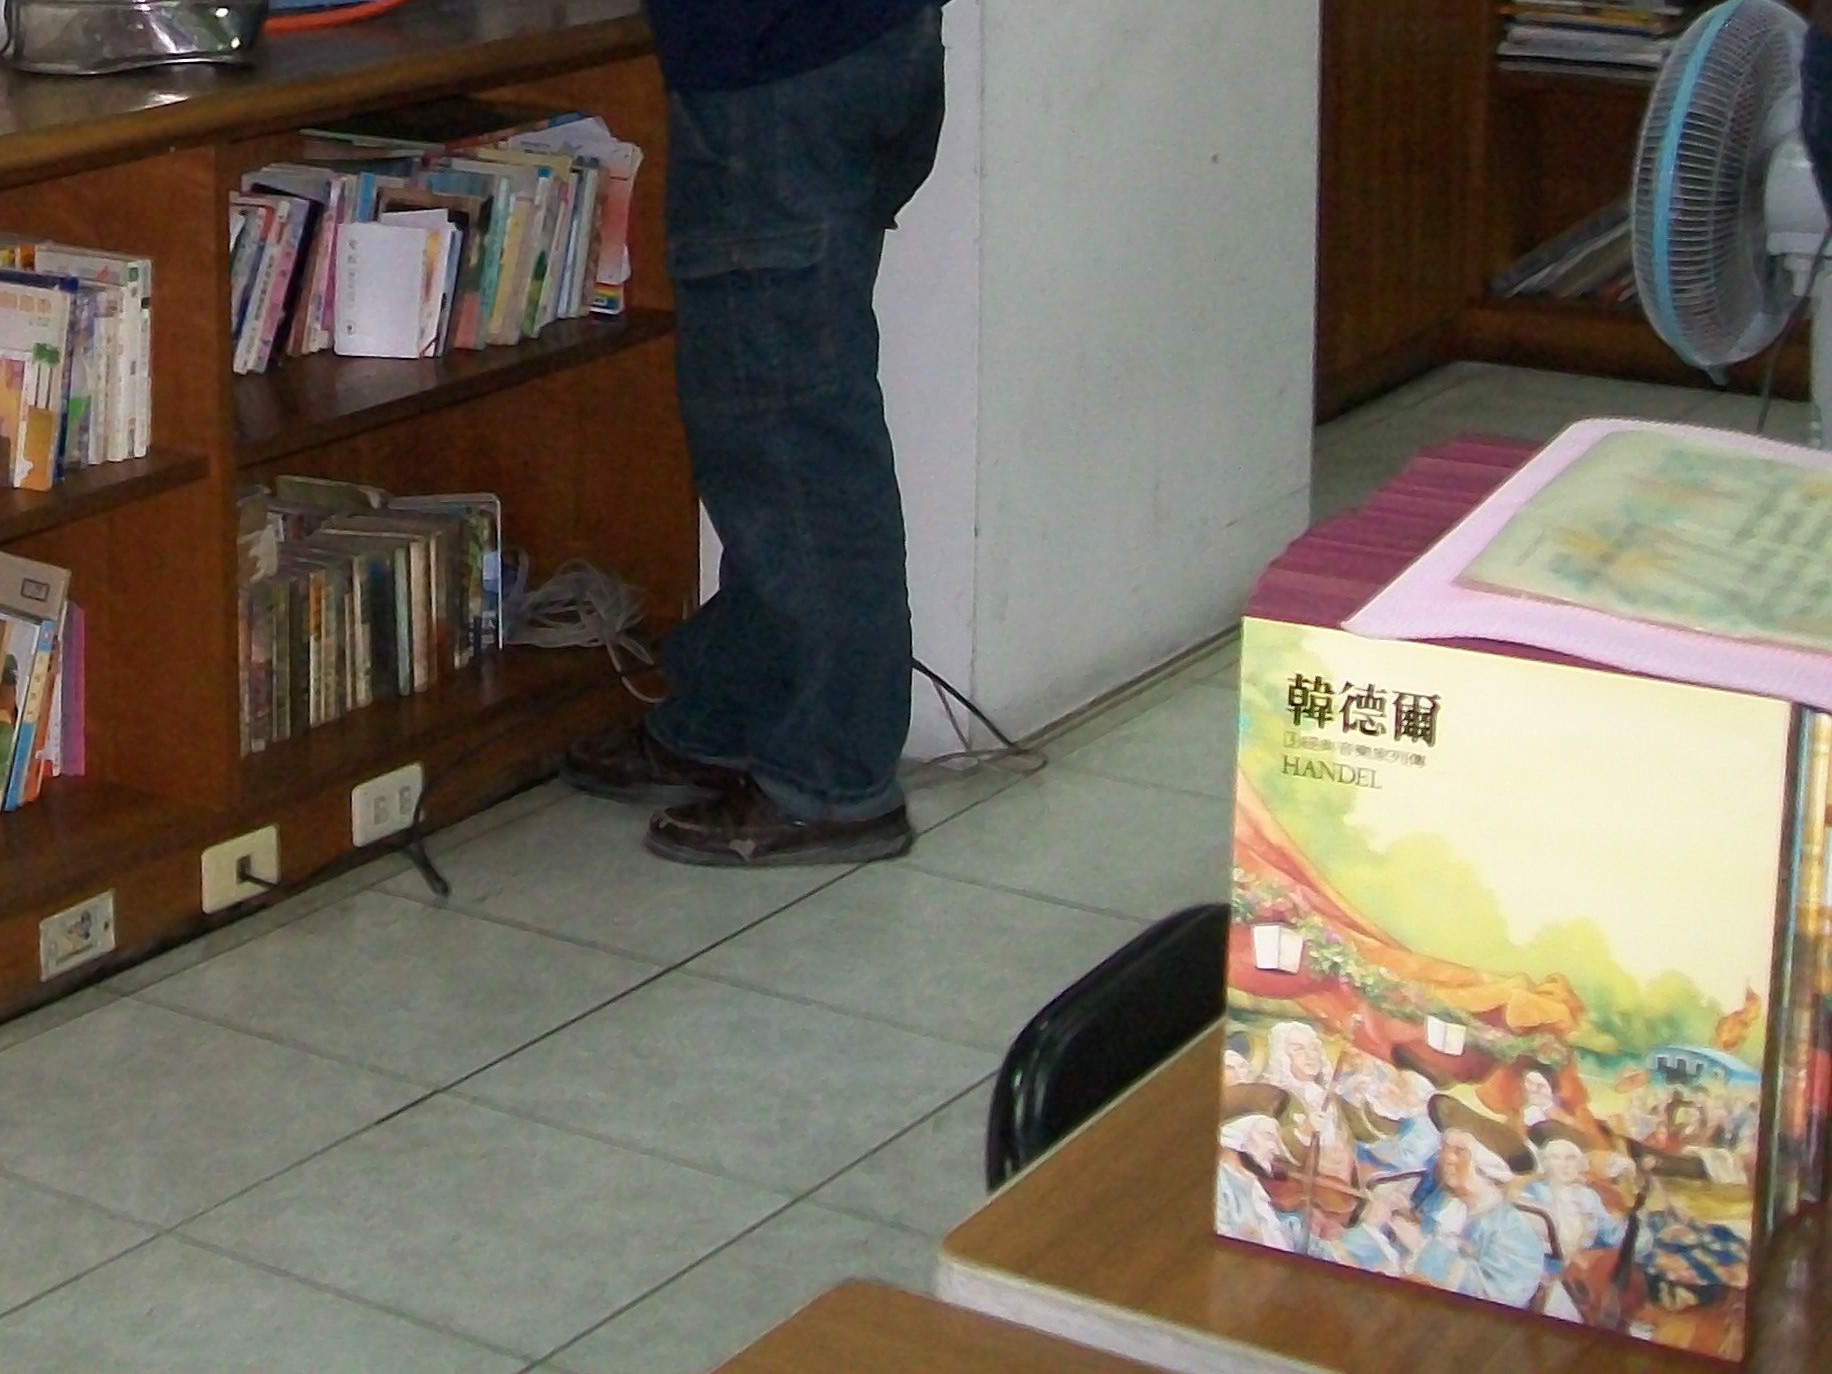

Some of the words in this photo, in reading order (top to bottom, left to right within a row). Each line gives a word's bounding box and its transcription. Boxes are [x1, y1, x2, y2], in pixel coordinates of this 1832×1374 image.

[1287, 673, 1442, 747] 韓德爾
[1281, 755, 1384, 789] HANDEL
